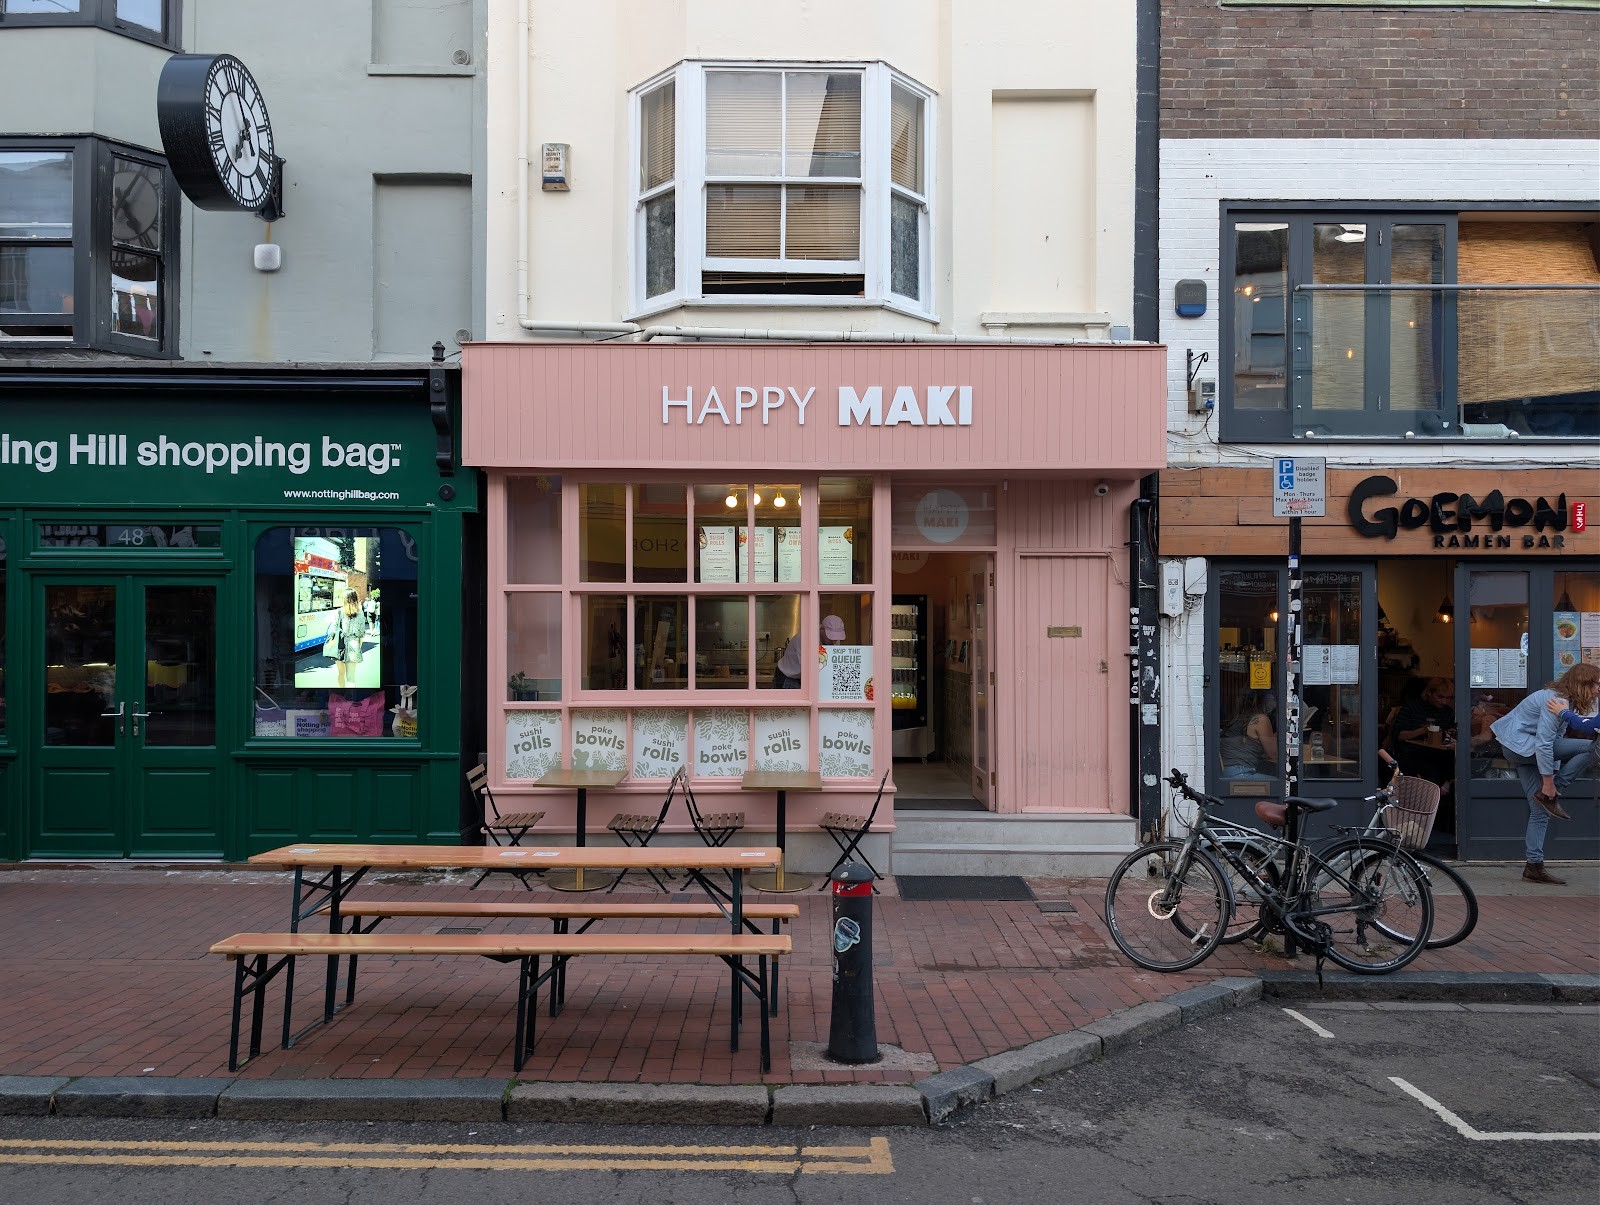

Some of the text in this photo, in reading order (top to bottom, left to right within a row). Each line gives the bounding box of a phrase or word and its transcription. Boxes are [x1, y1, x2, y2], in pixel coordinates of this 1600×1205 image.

[662, 386, 973, 426] HAPPY MAKI
[2, 434, 58, 473] ing
[70, 434, 126, 466] Hill
[136, 434, 310, 474] shopping
[284, 490, 399, 500] www.nottinghillbag.com
[924, 504, 960, 514] HAPPY
[1348, 476, 1568, 540] GOEMON
[924, 517, 959, 528] MAKI
[118, 528, 144, 546] 48
[1434, 534, 1565, 548] RAMEN BAR
[519, 727, 542, 738] sushi
[591, 726, 613, 735] poke
[768, 729, 790, 740] sushi
[837, 731, 858, 740] poke
[514, 735, 552, 754] rolls
[576, 731, 625, 750] bowls
[652, 737, 675, 748] sushi
[712, 743, 732, 751] poke
[764, 737, 801, 756] rolls
[822, 736, 872, 756] bowls
[643, 745, 679, 763] rolls
[700, 749, 747, 764] bowls
